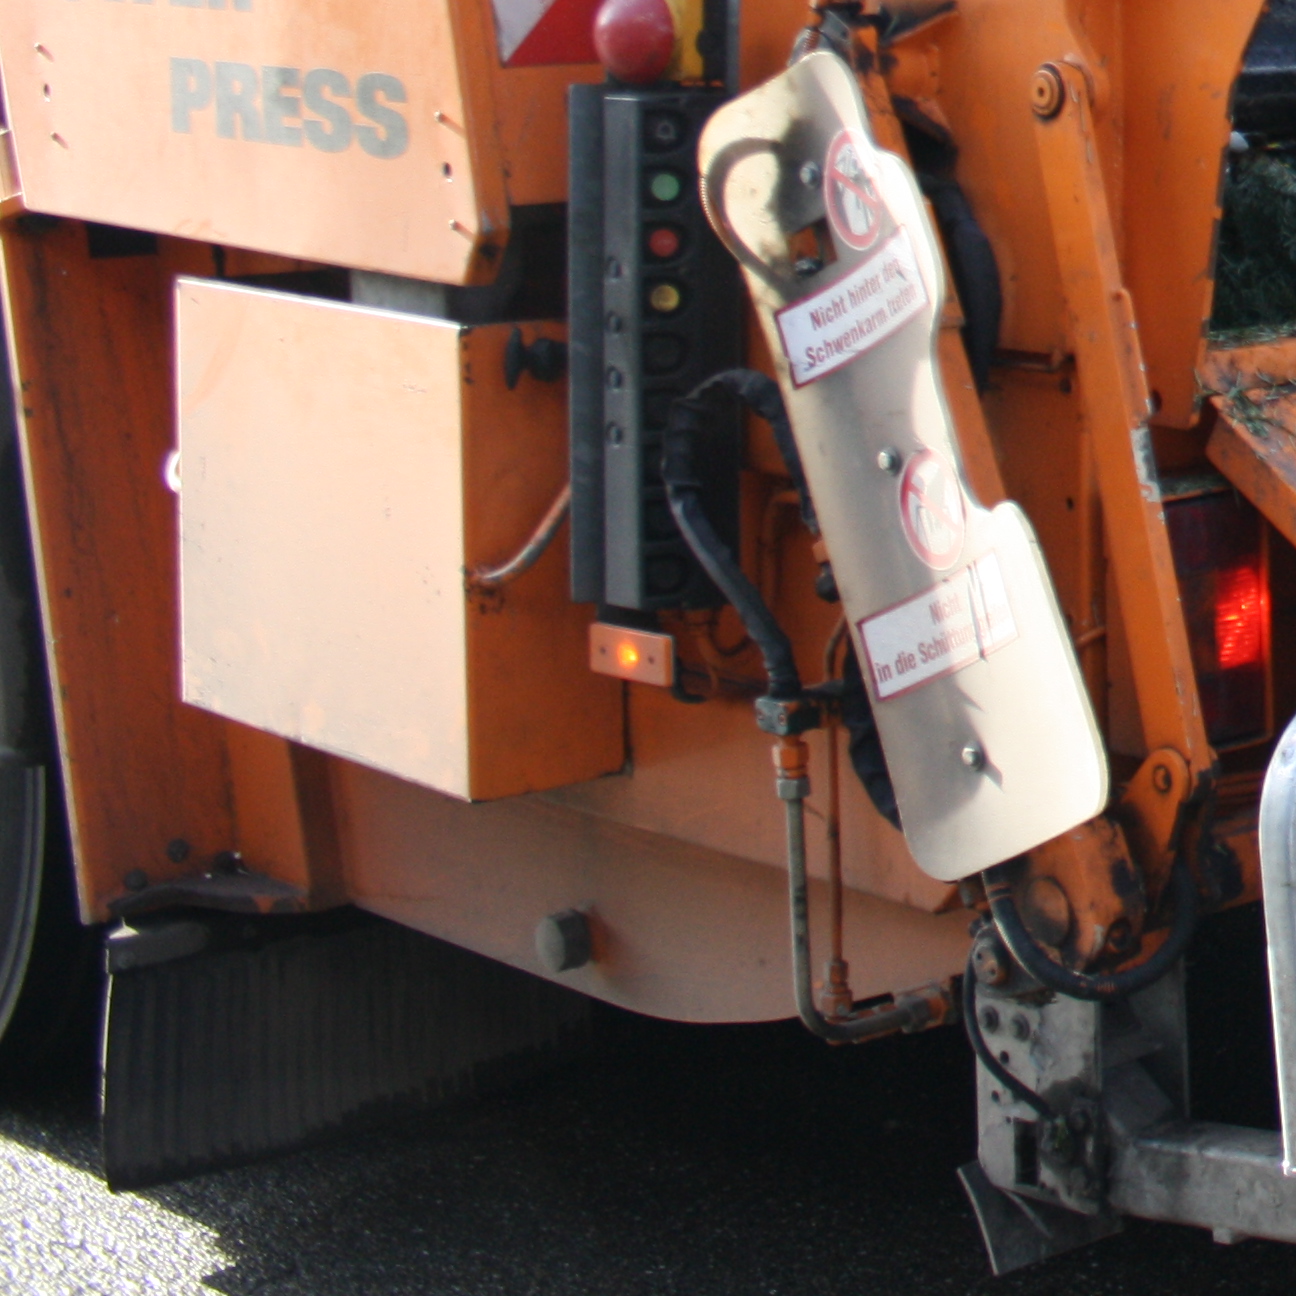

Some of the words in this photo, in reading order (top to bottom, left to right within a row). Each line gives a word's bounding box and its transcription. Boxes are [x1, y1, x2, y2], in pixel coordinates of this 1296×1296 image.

[168, 55, 411, 160] PRESS
[809, 295, 849, 331] Nicht
[847, 274, 883, 309] hinter
[804, 306, 889, 369] Schwenkarm
[929, 592, 963, 626] Nicht
[874, 662, 893, 684] in
[894, 649, 918, 676] die
